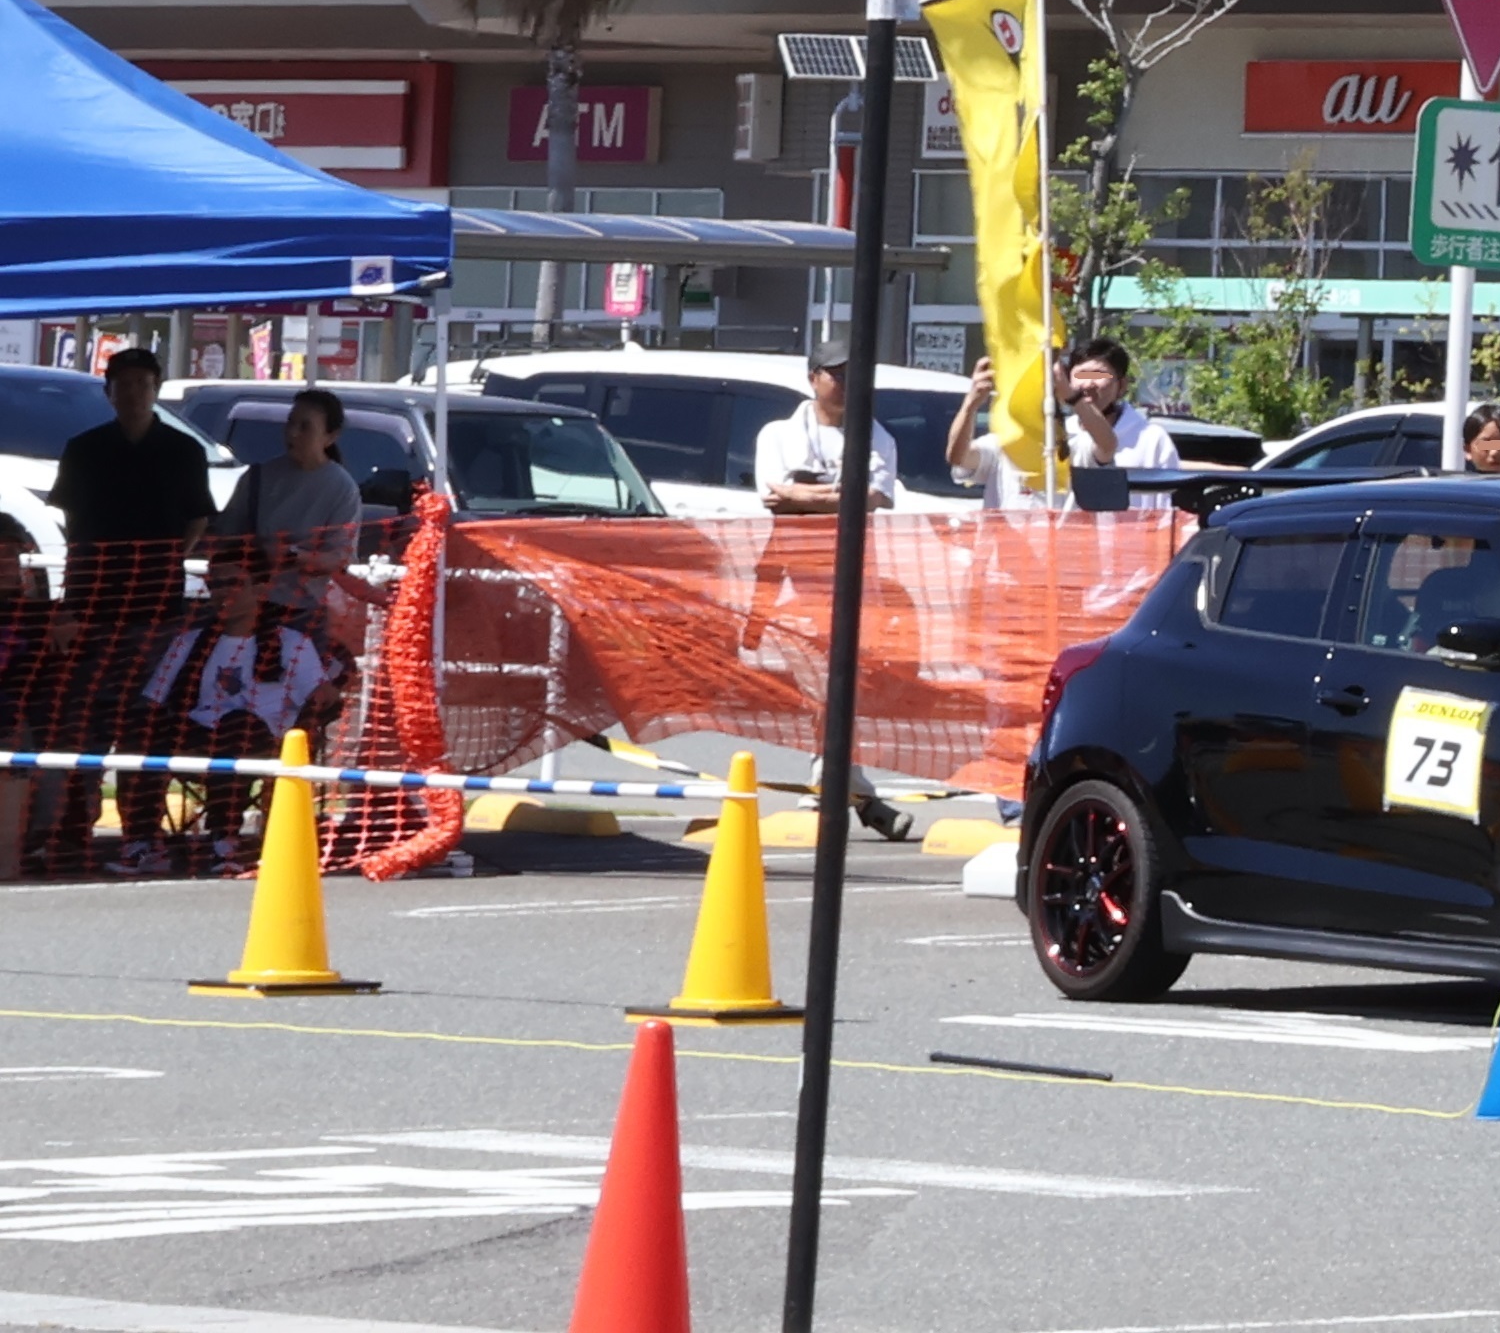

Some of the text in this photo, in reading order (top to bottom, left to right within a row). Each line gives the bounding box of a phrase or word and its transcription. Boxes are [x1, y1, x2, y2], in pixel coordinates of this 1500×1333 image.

[1322, 73, 1413, 124] au
[1418, 702, 1482, 722] DUNLOP
[1405, 736, 1463, 788] 73
